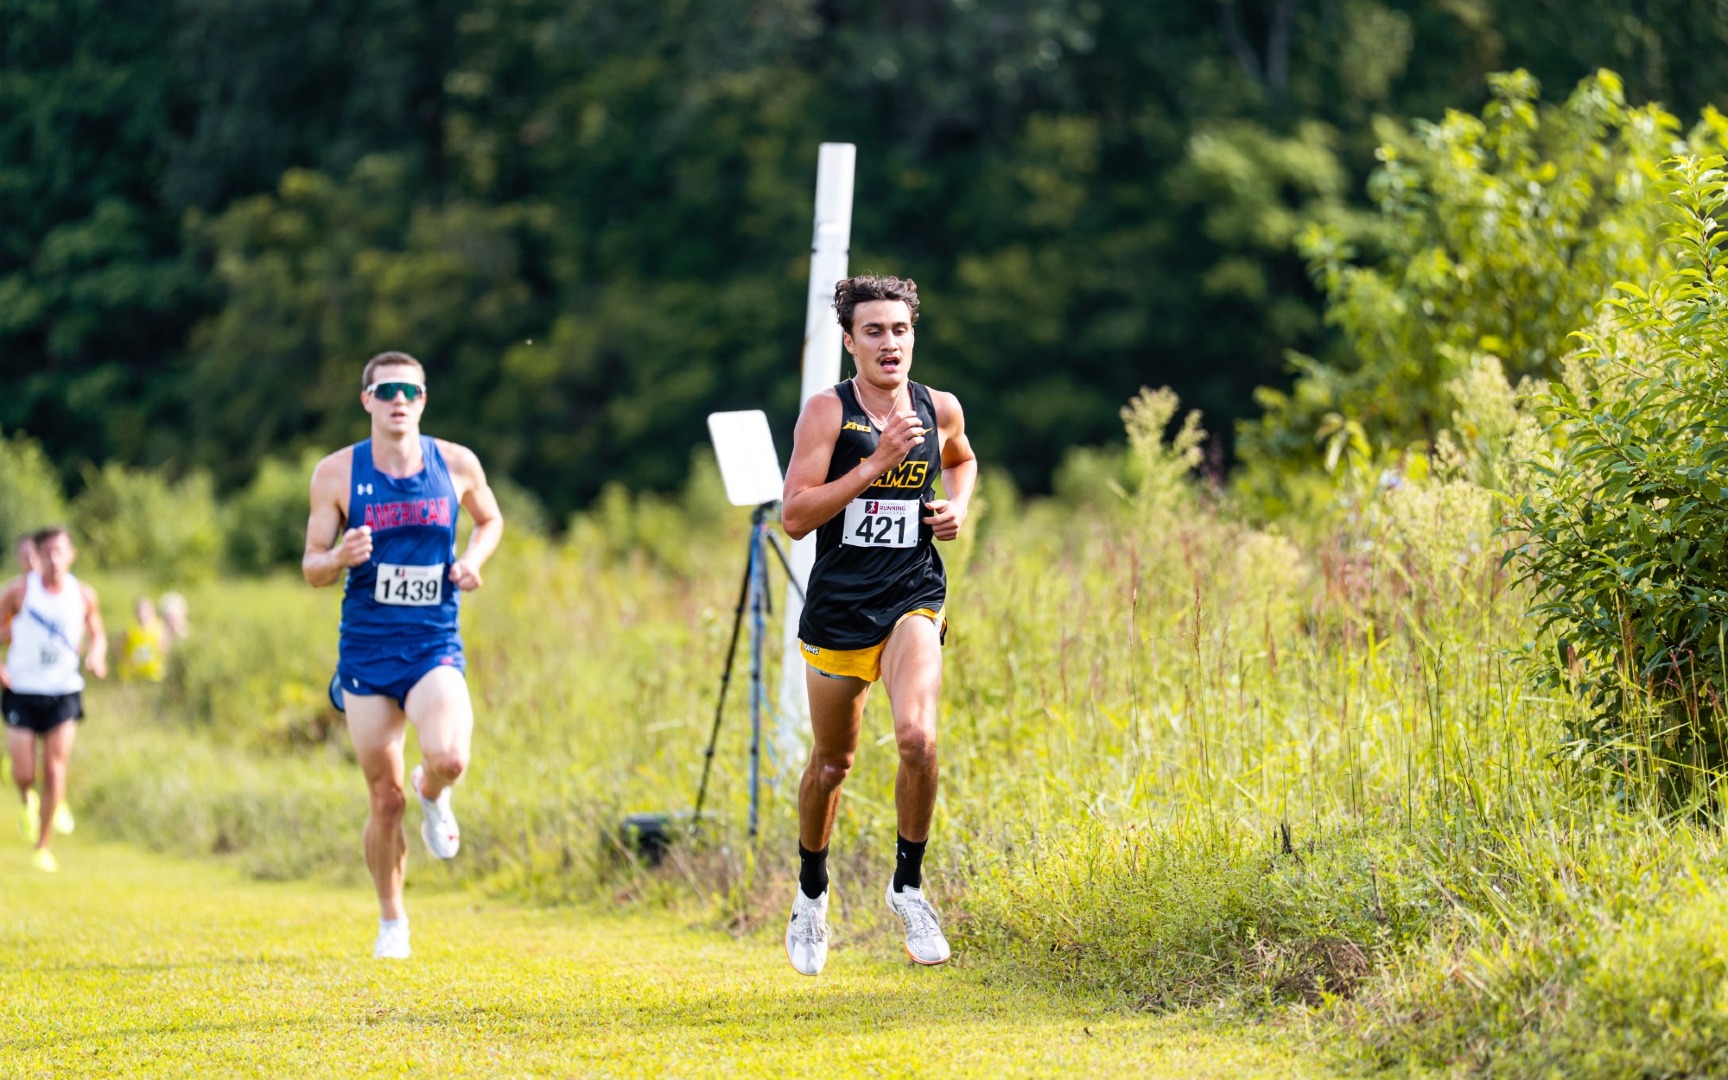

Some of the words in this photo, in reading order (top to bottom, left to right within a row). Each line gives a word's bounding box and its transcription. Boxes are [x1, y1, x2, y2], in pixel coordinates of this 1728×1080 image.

[861, 458, 929, 488] AMS
[364, 497, 450, 532] AMERICAN
[855, 516, 906, 544] 421
[381, 579, 438, 602] 1439
